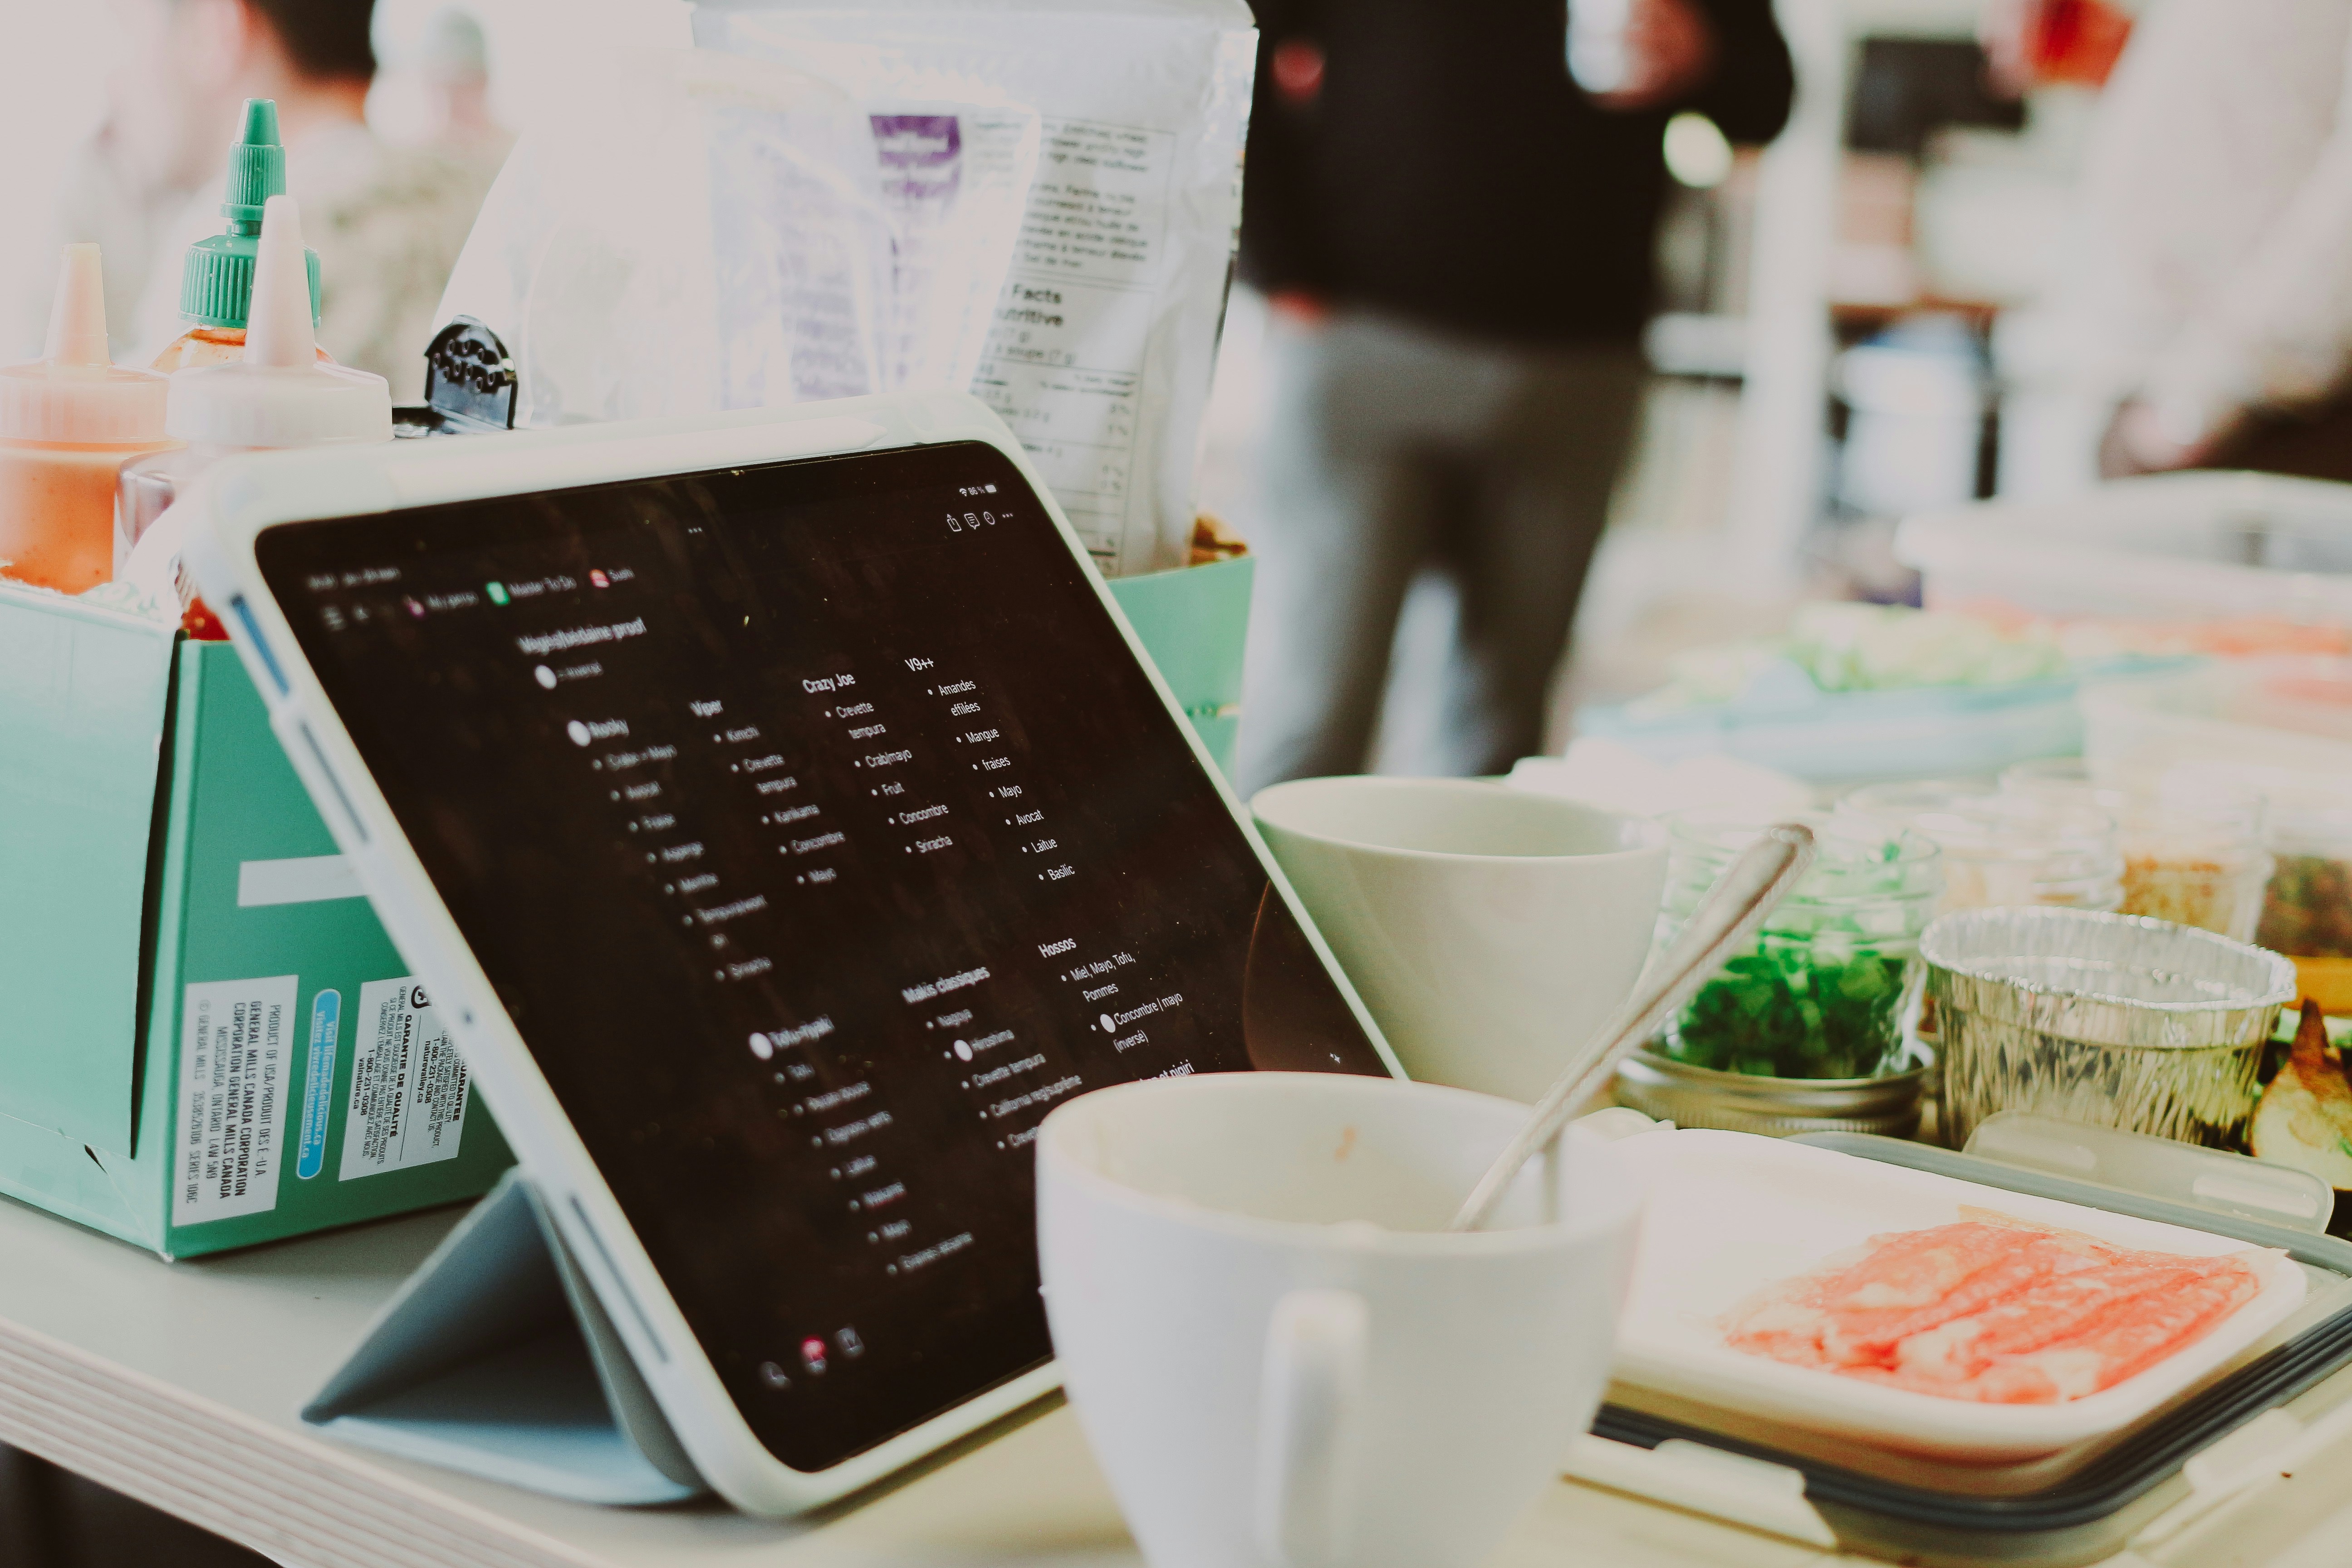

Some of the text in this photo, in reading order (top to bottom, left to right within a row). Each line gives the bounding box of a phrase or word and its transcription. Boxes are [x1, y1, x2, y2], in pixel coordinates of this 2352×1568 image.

[905, 657, 934, 671] V9++
[803, 673, 856, 693] Crazy Joe
[938, 680, 976, 696] Amandes
[836, 702, 875, 719] Crevette
[951, 701, 981, 717] effilées
[848, 723, 887, 740] tempura
[965, 727, 1000, 744] Mangue
[982, 755, 1011, 771] fraises
[882, 781, 905, 797] Fruit
[998, 784, 1022, 799] Mayo
[898, 804, 949, 825] Concombre
[1016, 809, 1044, 826] Avocat
[915, 835, 953, 854] Sriracha
[1031, 837, 1058, 853] Laitue
[1048, 863, 1075, 881] Basilic
[1038, 938, 1077, 958] Hossos
[1069, 951, 1137, 982] Miel, Mayo, Tofu,
[397, 986, 407, 1012] GENERAL
[1083, 983, 1119, 1002] Pommes
[1114, 1003, 1158, 1026] Concombre
[1161, 992, 1183, 1010] mayo
[266, 1004, 282, 1045] PRODUCT
[395, 1013, 403, 1030] MILLS
[1113, 1029, 1149, 1054] (inversé)
[265, 1049, 278, 1061] OF
[382, 1048, 391, 1063] VOUS
[389, 1014, 412, 1138] GARANTIE DE QUALITÉ
[416, 1040, 432, 1104] naturevalley.ca
[424, 1037, 440, 1104] 1-800-231-0308
[435, 1058, 445, 1083] PACKAGE
[441, 1066, 451, 1093] SATISFIED
[449, 1058, 460, 1092] COMMITTED
[353, 1057, 366, 1109] valnature.ca
[360, 1049, 375, 1116] 1-800-231-0308
[378, 1084, 387, 1095] PAS
[433, 1084, 441, 1096] AND
[452, 1060, 468, 1122] UARANTEE
[219, 1002, 246, 1199] CORPORATION GENERAL MILLS CANADA
[234, 1000, 262, 1196] GENERAL MILLS CANADA CORPORATION
[260, 1063, 277, 1125] USA/PRODUIT
[438, 1093, 446, 1107] WITH
[209, 1093, 224, 1132] ONTARIO
[429, 1097, 439, 1122] CONTACT
[436, 1107, 445, 1121] THIS
[258, 1128, 270, 1145] DES
[364, 1125, 373, 1140] AVEC
[431, 1121, 442, 1148] PRODUCT,
[207, 1137, 220, 1158] L4W
[206, 1160, 219, 1179] 5N9
